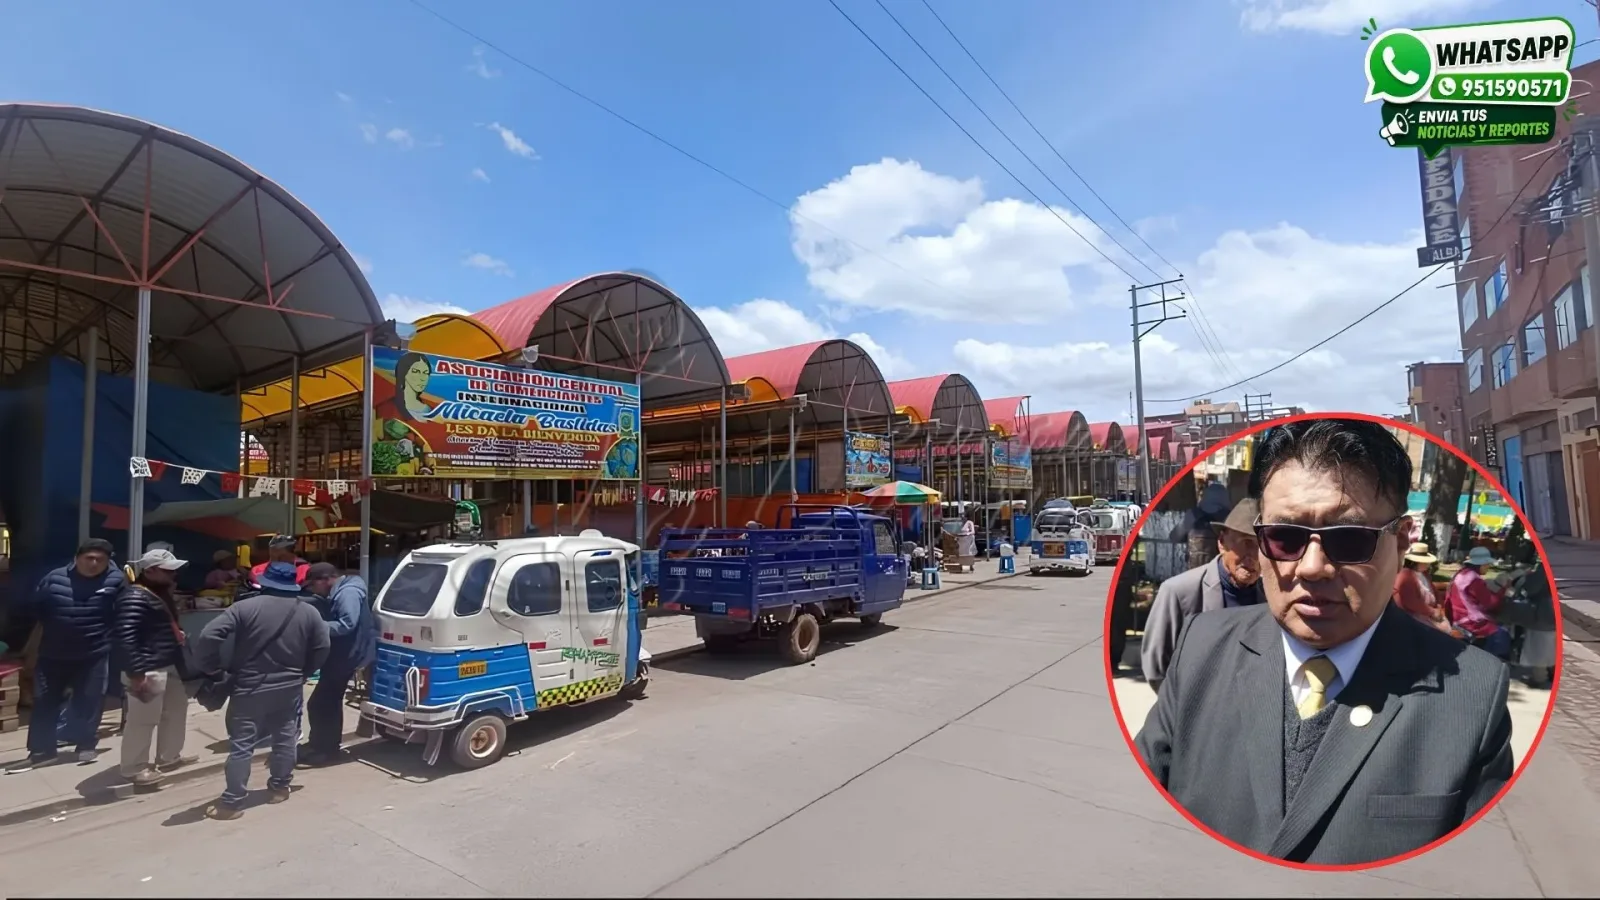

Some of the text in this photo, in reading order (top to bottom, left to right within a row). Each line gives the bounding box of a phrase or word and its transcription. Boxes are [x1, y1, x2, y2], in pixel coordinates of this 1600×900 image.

[1424, 149, 1457, 245] PEDAJE
[469, 379, 603, 404] DE COMERCIANTES
[559, 378, 624, 397] CENTRAL
[426, 400, 528, 424] Micaela
[457, 391, 586, 414] INTERNACIONAL
[446, 424, 600, 443] LES DA LA BIENVENIDA
